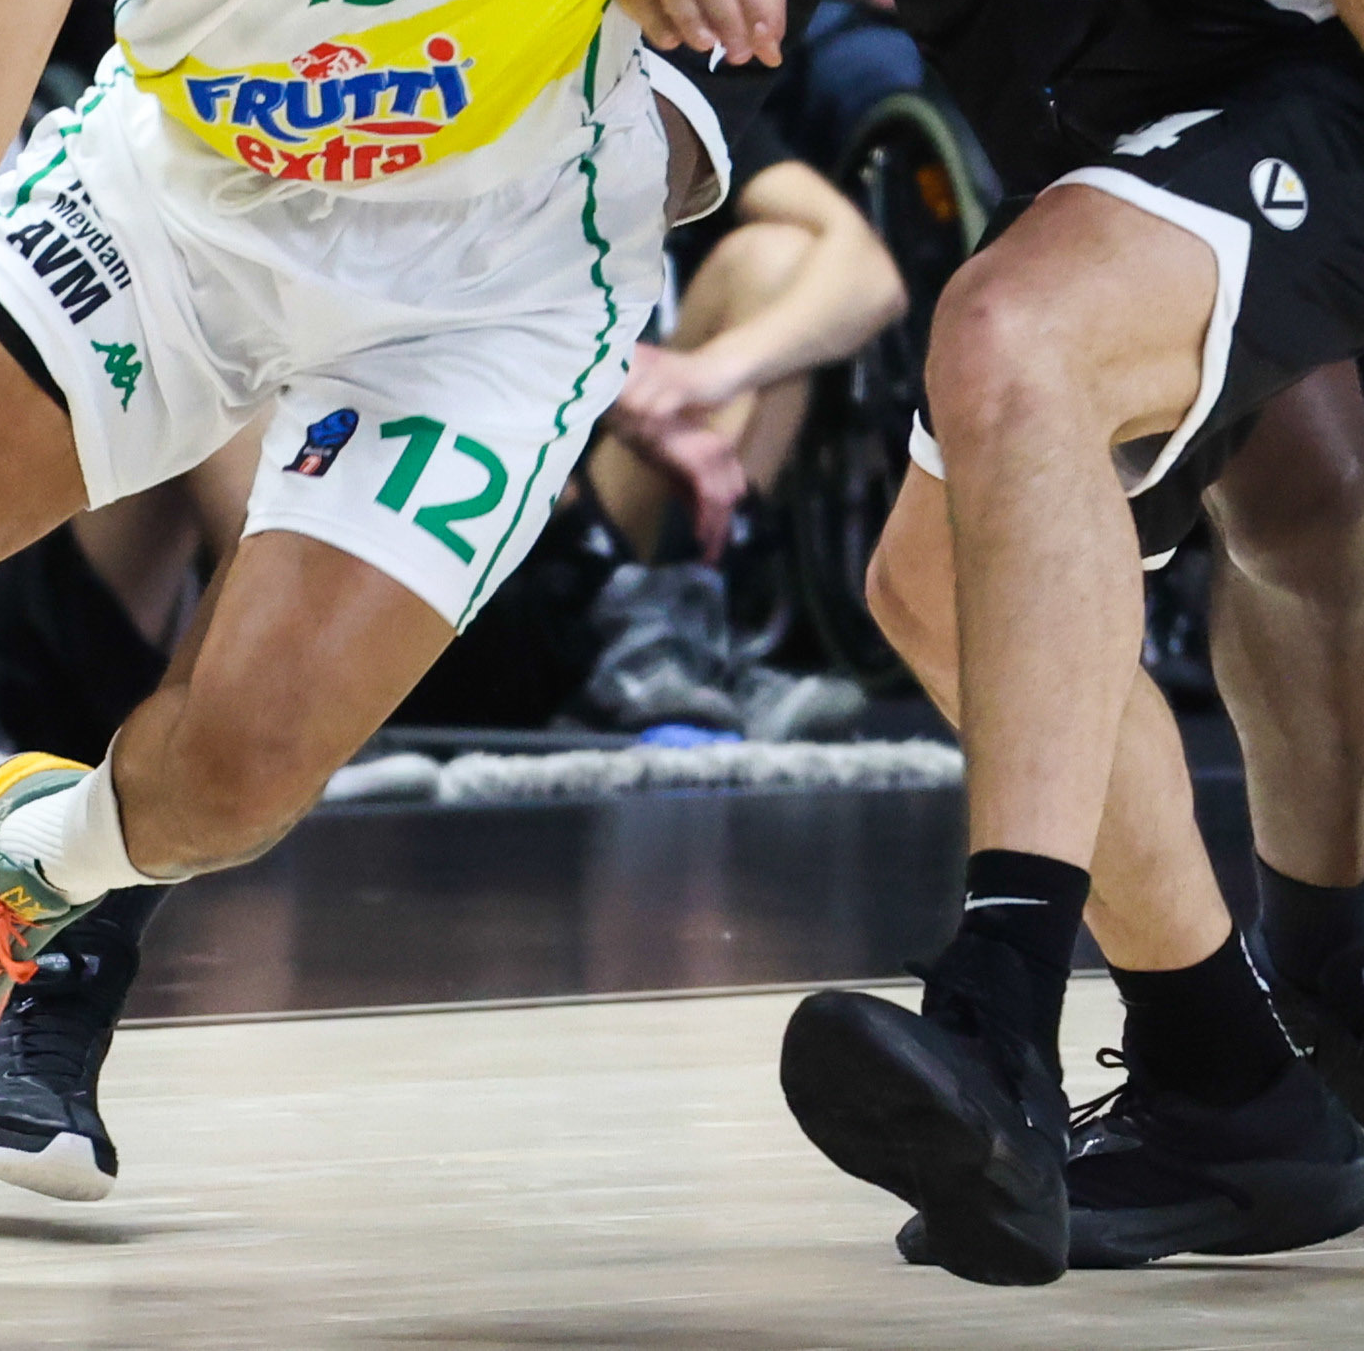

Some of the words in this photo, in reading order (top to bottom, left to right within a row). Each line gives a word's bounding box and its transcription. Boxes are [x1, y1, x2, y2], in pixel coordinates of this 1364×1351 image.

[236, 135, 423, 181] extra
[6, 219, 113, 326] AVM
[374, 415, 509, 568] 12
